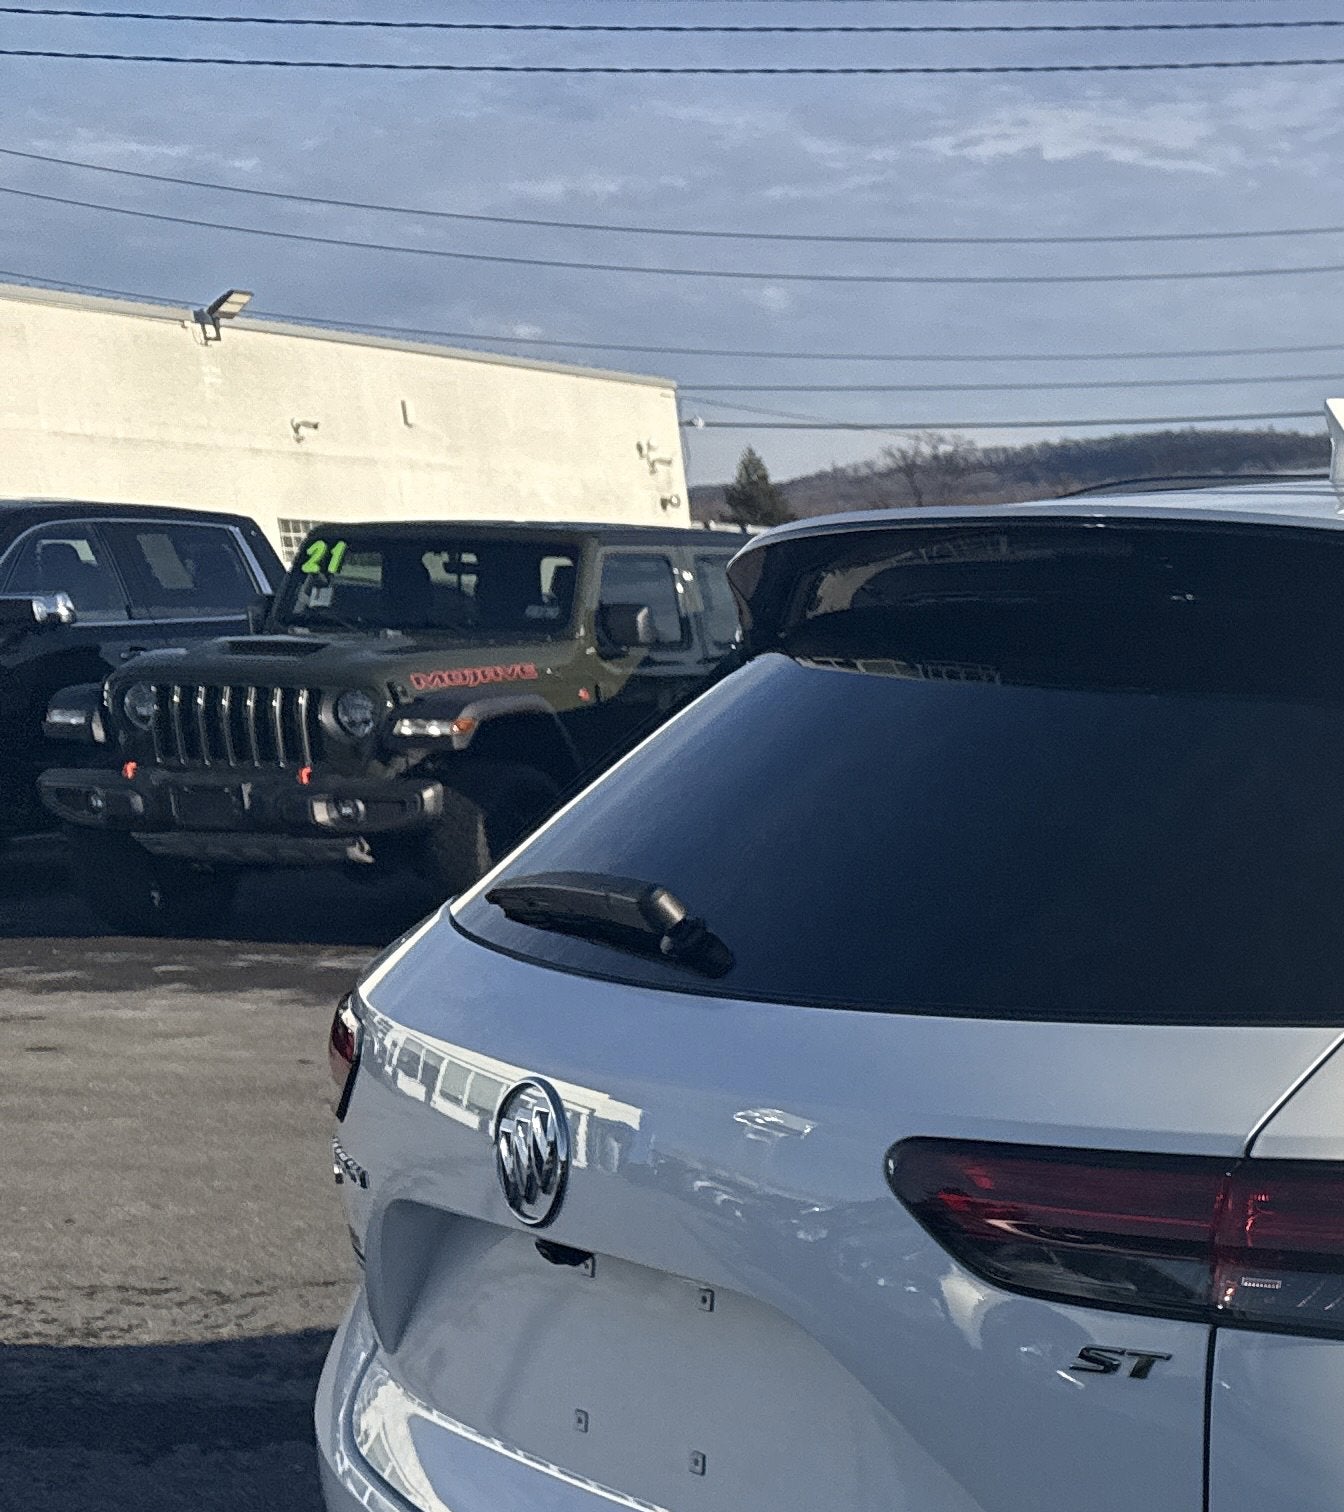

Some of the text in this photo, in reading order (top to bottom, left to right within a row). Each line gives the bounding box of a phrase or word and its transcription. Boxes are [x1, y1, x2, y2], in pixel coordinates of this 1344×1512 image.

[302, 540, 347, 573] 21
[410, 662, 538, 690] MOJAVE
[1069, 1344, 1173, 1379] ST
